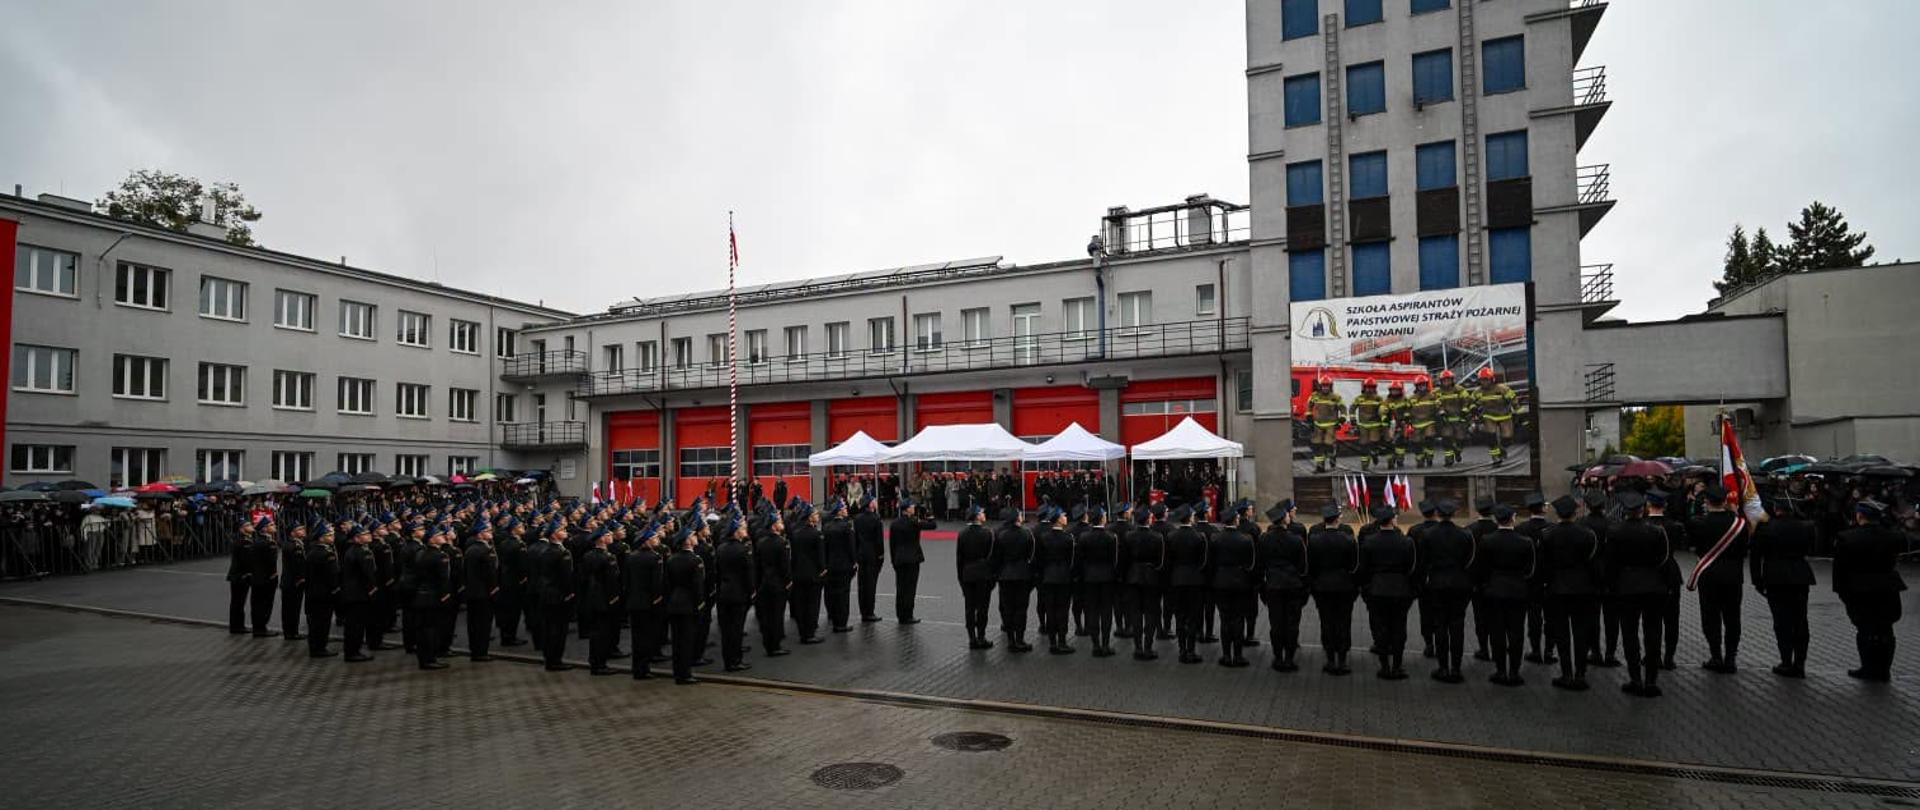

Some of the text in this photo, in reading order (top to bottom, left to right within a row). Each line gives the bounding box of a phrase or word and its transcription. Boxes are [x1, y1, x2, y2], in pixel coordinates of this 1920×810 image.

[1346, 298, 1464, 315] SZKOŁA ASPIRANTÓW
[1347, 305, 1521, 327] PAŃSTWOWEJ STRAŻY POŻARNEJ
[1347, 327, 1415, 339] W POZNANIU
